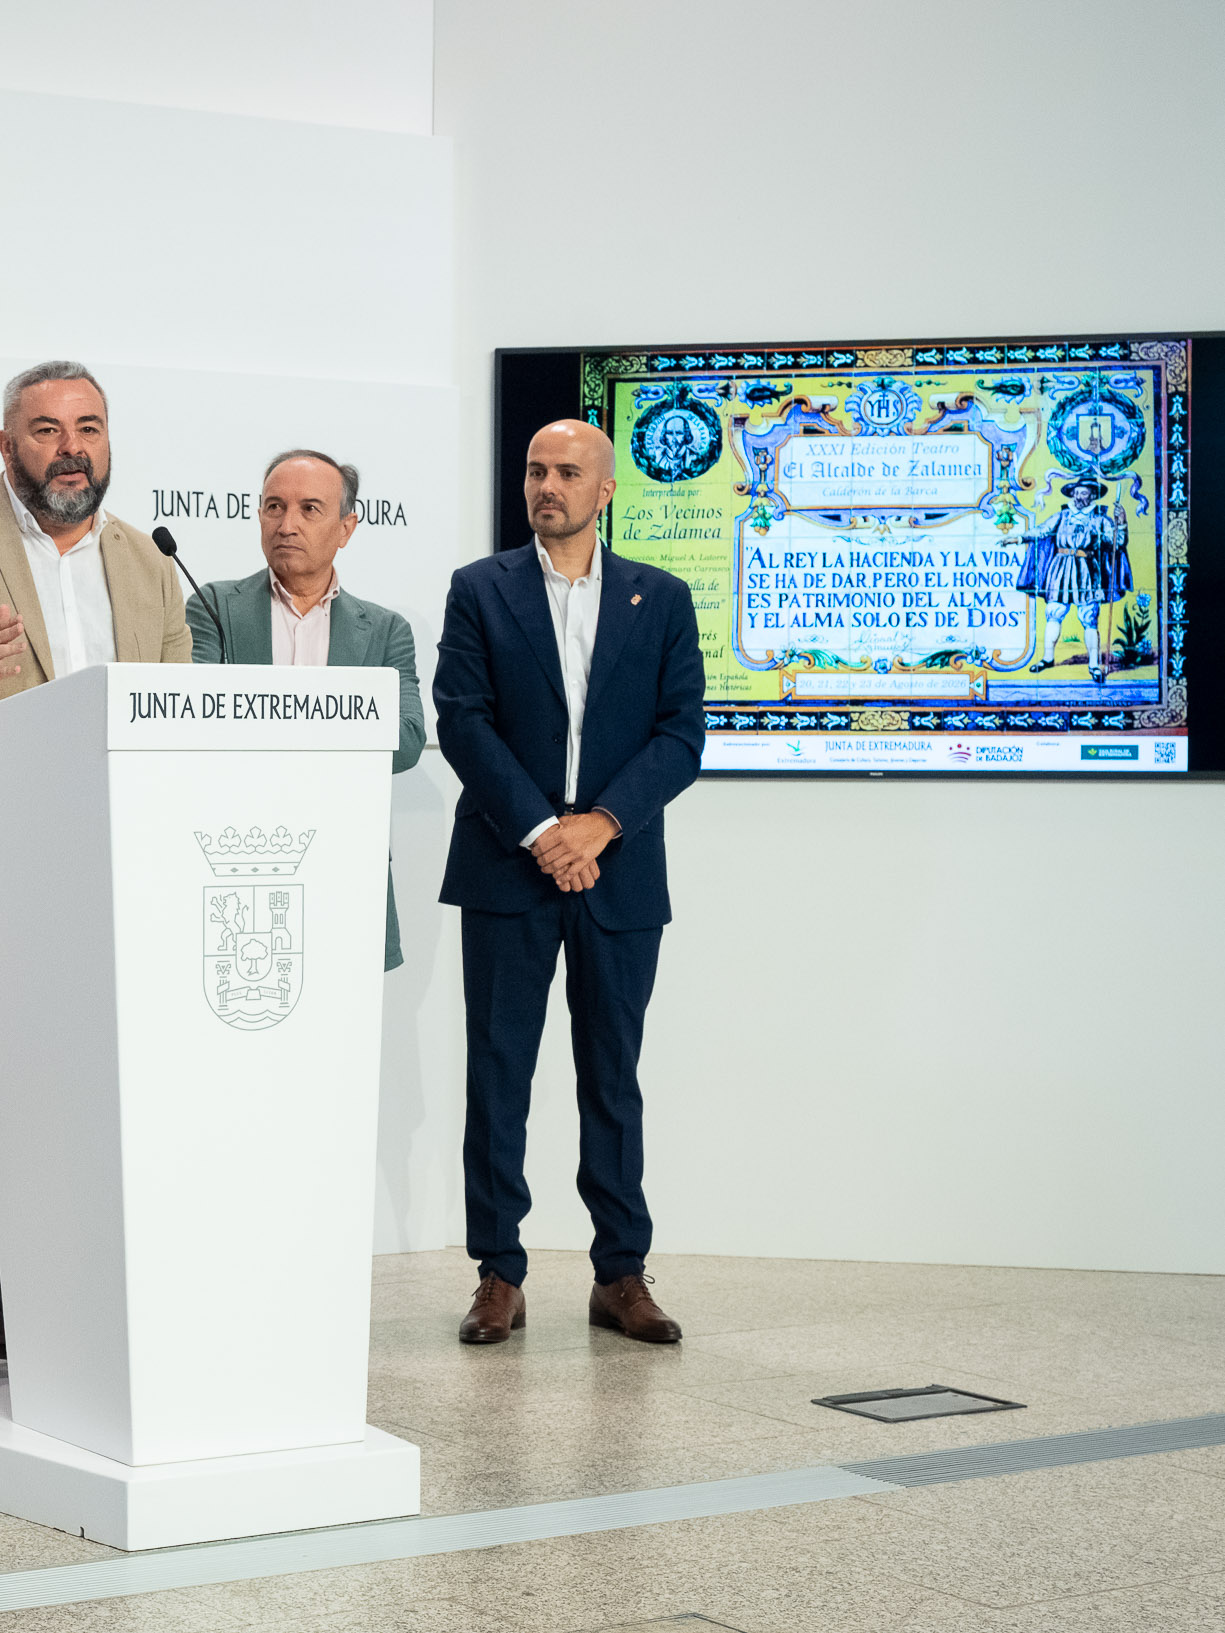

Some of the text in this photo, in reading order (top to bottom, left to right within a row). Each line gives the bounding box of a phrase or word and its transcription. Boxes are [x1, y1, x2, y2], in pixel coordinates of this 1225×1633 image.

[805, 442, 960, 456] XXXI Edición Teatro
[783, 460, 982, 479] El Alcalde de Zalamea
[875, 487, 887, 496] de
[891, 487, 900, 496] la
[905, 486, 938, 496] Barca
[152, 489, 251, 521] JUNTA DE
[621, 504, 722, 520] Los Vecinos
[623, 522, 721, 540] de Zalamea
[784, 552, 818, 569] REY
[822, 552, 845, 568] LA
[849, 551, 935, 568] HACIENDA
[940, 551, 951, 567] Y
[955, 551, 977, 567] LA
[981, 550, 1023, 567] VIDA
[707, 579, 719, 591] de
[747, 572, 771, 589] SE
[775, 573, 798, 589] HA
[803, 572, 827, 589] DE
[872, 572, 919, 588] PERO
[924, 572, 949, 588] EL
[952, 571, 1014, 588] HONOR
[747, 591, 1006, 609] ES PATRIMONIO DEL ALMA
[747, 612, 758, 628] Y
[763, 612, 785, 628] EL
[790, 612, 845, 628] ALMA
[851, 611, 901, 628] SOLO
[905, 611, 929, 628] ES
[934, 611, 960, 628] DE
[874, 678, 887, 689] de
[889, 679, 924, 690] Agosto
[926, 678, 939, 689] de
[129, 692, 380, 723] JUNTA DE EXTREMADURA
[825, 740, 933, 752] JUNTA DE EXTREMADURA
[975, 745, 1024, 755] DIPUTACIÓN
[985, 754, 1023, 762] BADAJOZ
